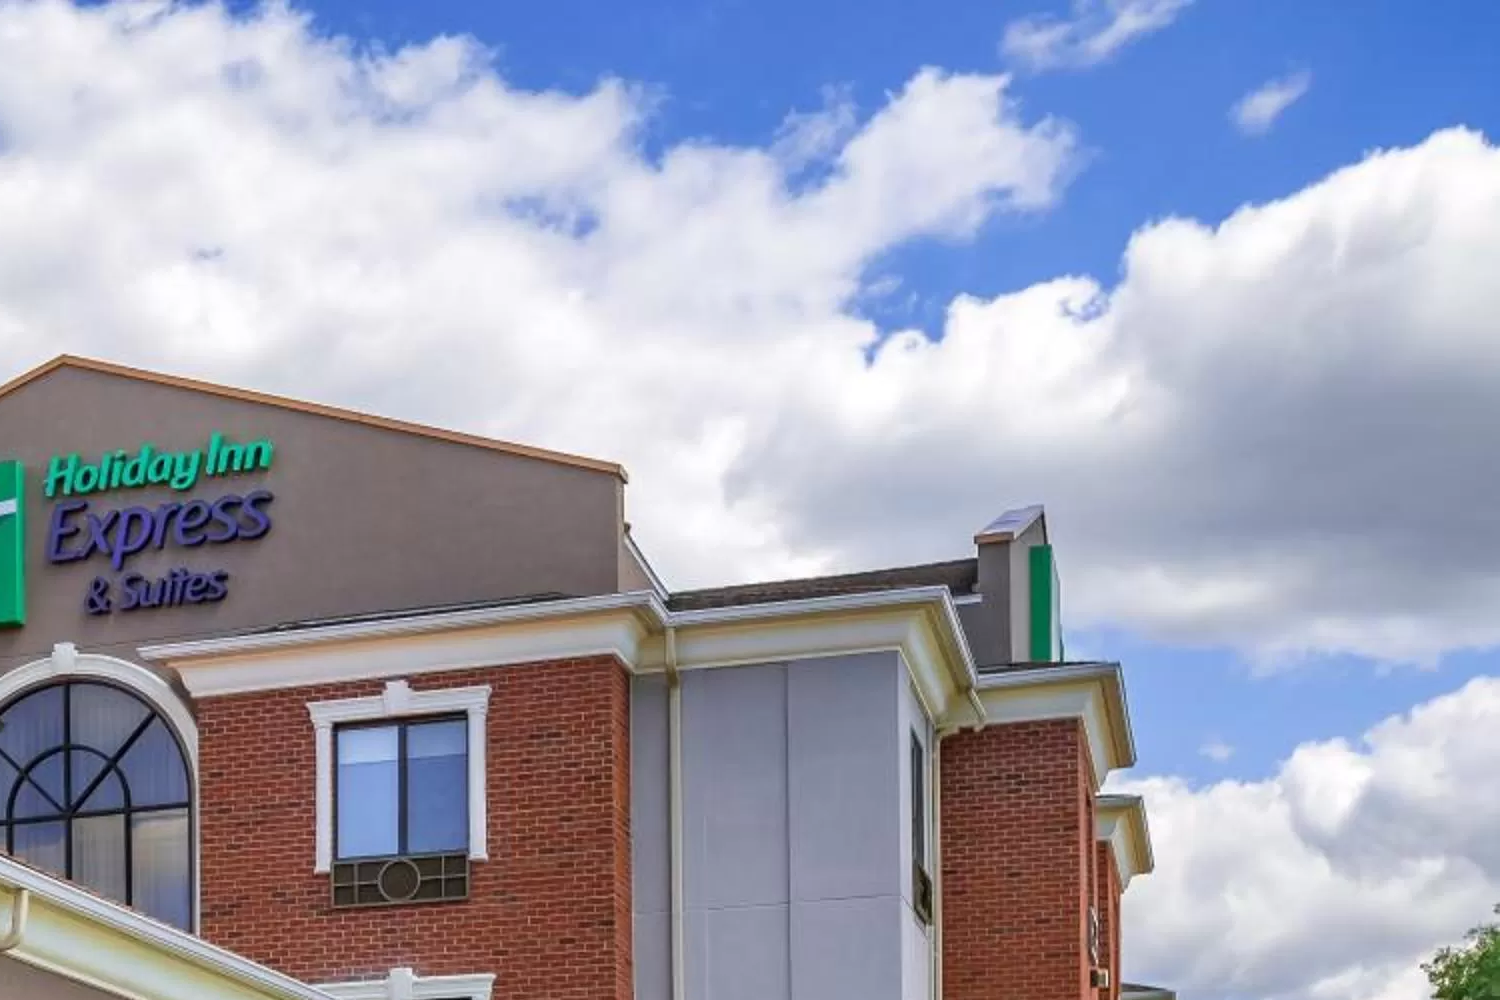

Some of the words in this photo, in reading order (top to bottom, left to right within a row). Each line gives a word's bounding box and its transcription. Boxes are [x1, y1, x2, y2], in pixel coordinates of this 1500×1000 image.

[44, 444, 202, 498] Holiday
[206, 431, 273, 476] Inn
[48, 491, 274, 571] Express
[85, 576, 111, 615] &
[120, 568, 229, 610] Suites
